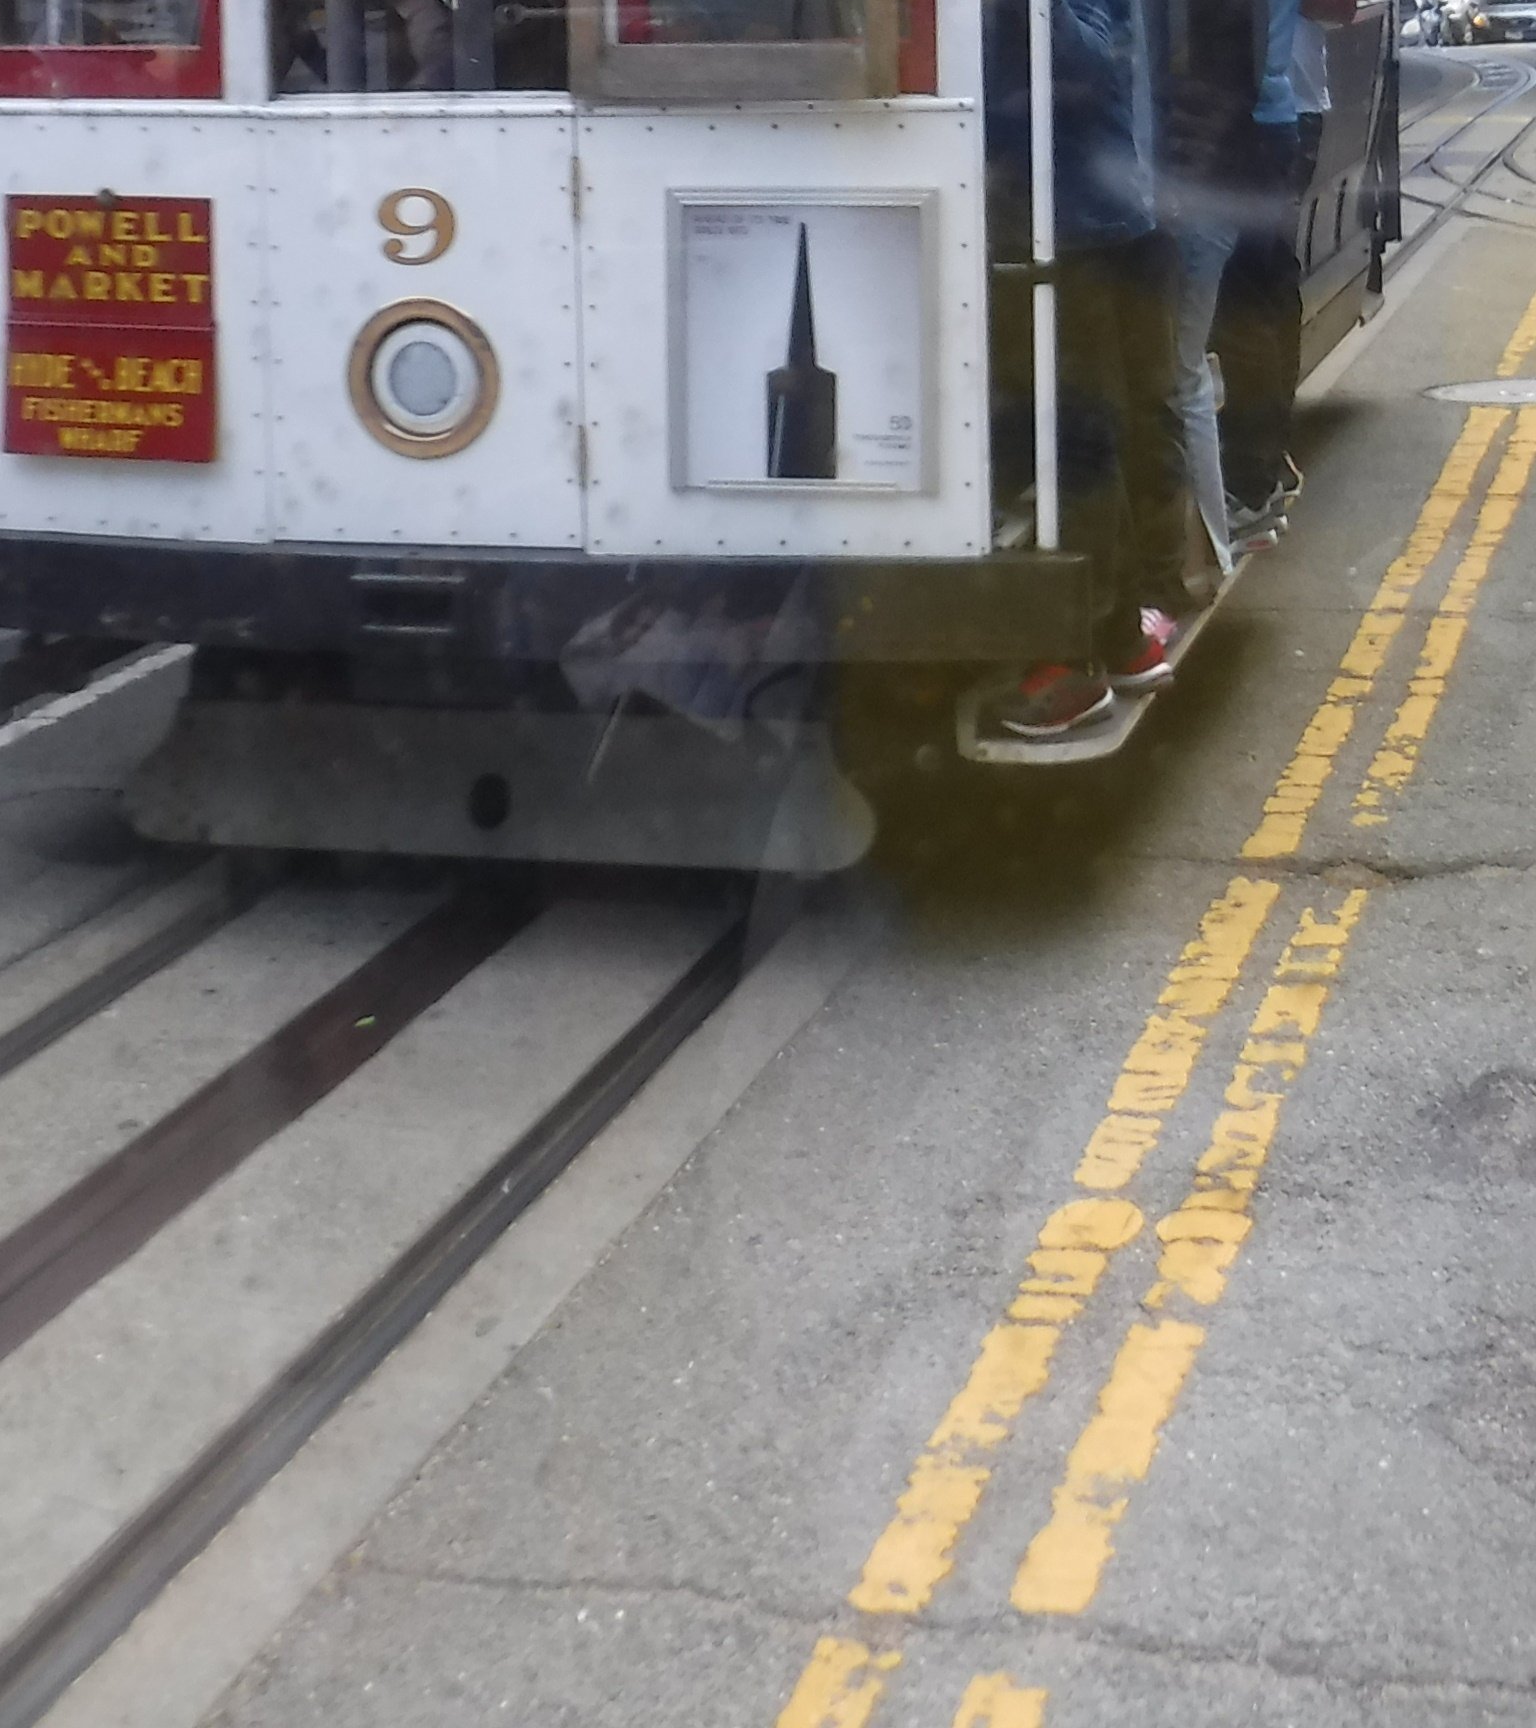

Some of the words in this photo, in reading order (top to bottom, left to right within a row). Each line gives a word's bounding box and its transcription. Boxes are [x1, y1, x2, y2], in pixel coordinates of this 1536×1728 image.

[14, 208, 209, 244] POWELL
[377, 187, 455, 266] 9
[65, 243, 160, 268] AND
[12, 269, 209, 303] MARKET
